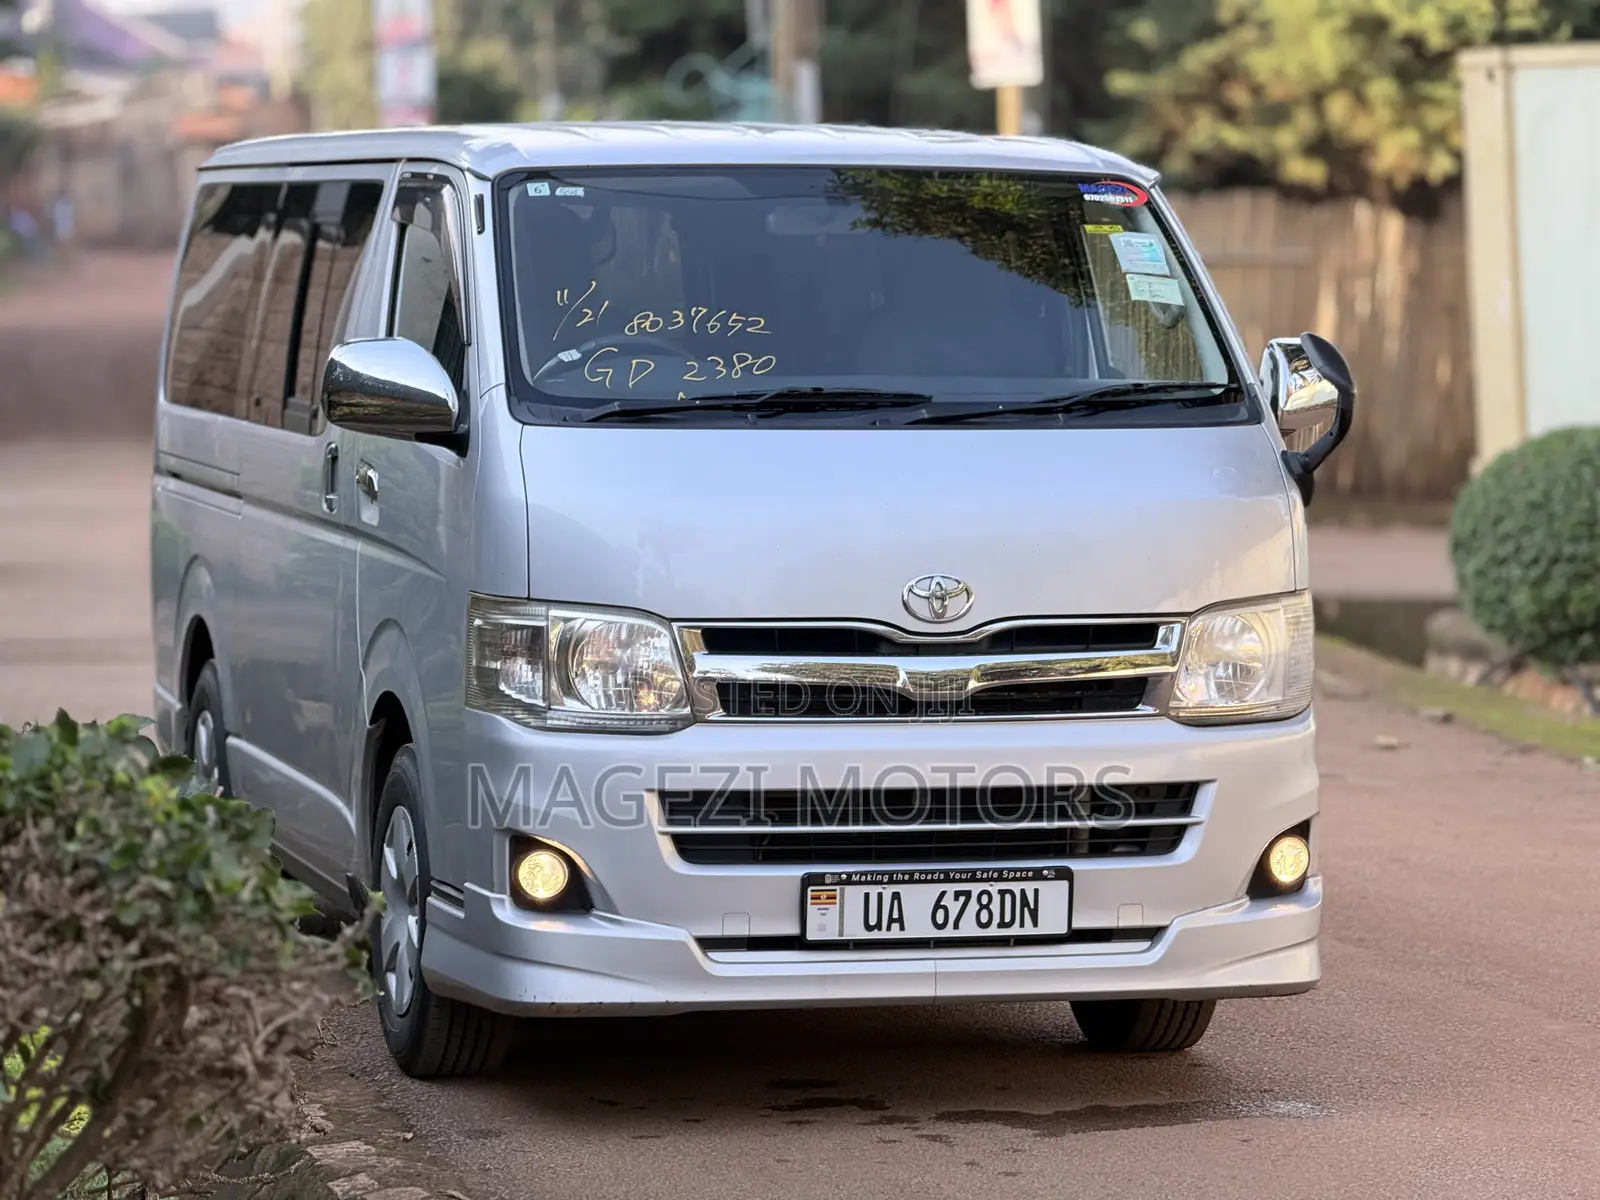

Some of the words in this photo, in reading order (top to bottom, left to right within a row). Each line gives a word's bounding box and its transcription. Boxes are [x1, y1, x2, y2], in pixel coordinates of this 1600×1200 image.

[624, 307, 772, 337] 8037652
[683, 353, 776, 382] 2380
[851, 872, 889, 883] Making
[893, 872, 910, 881] the
[913, 871, 945, 881] Roads
[949, 870, 972, 880] Your
[975, 869, 999, 880] Safe
[1002, 869, 1034, 880] Space
[863, 891, 906, 933] UA
[930, 887, 1040, 931] 678DN
